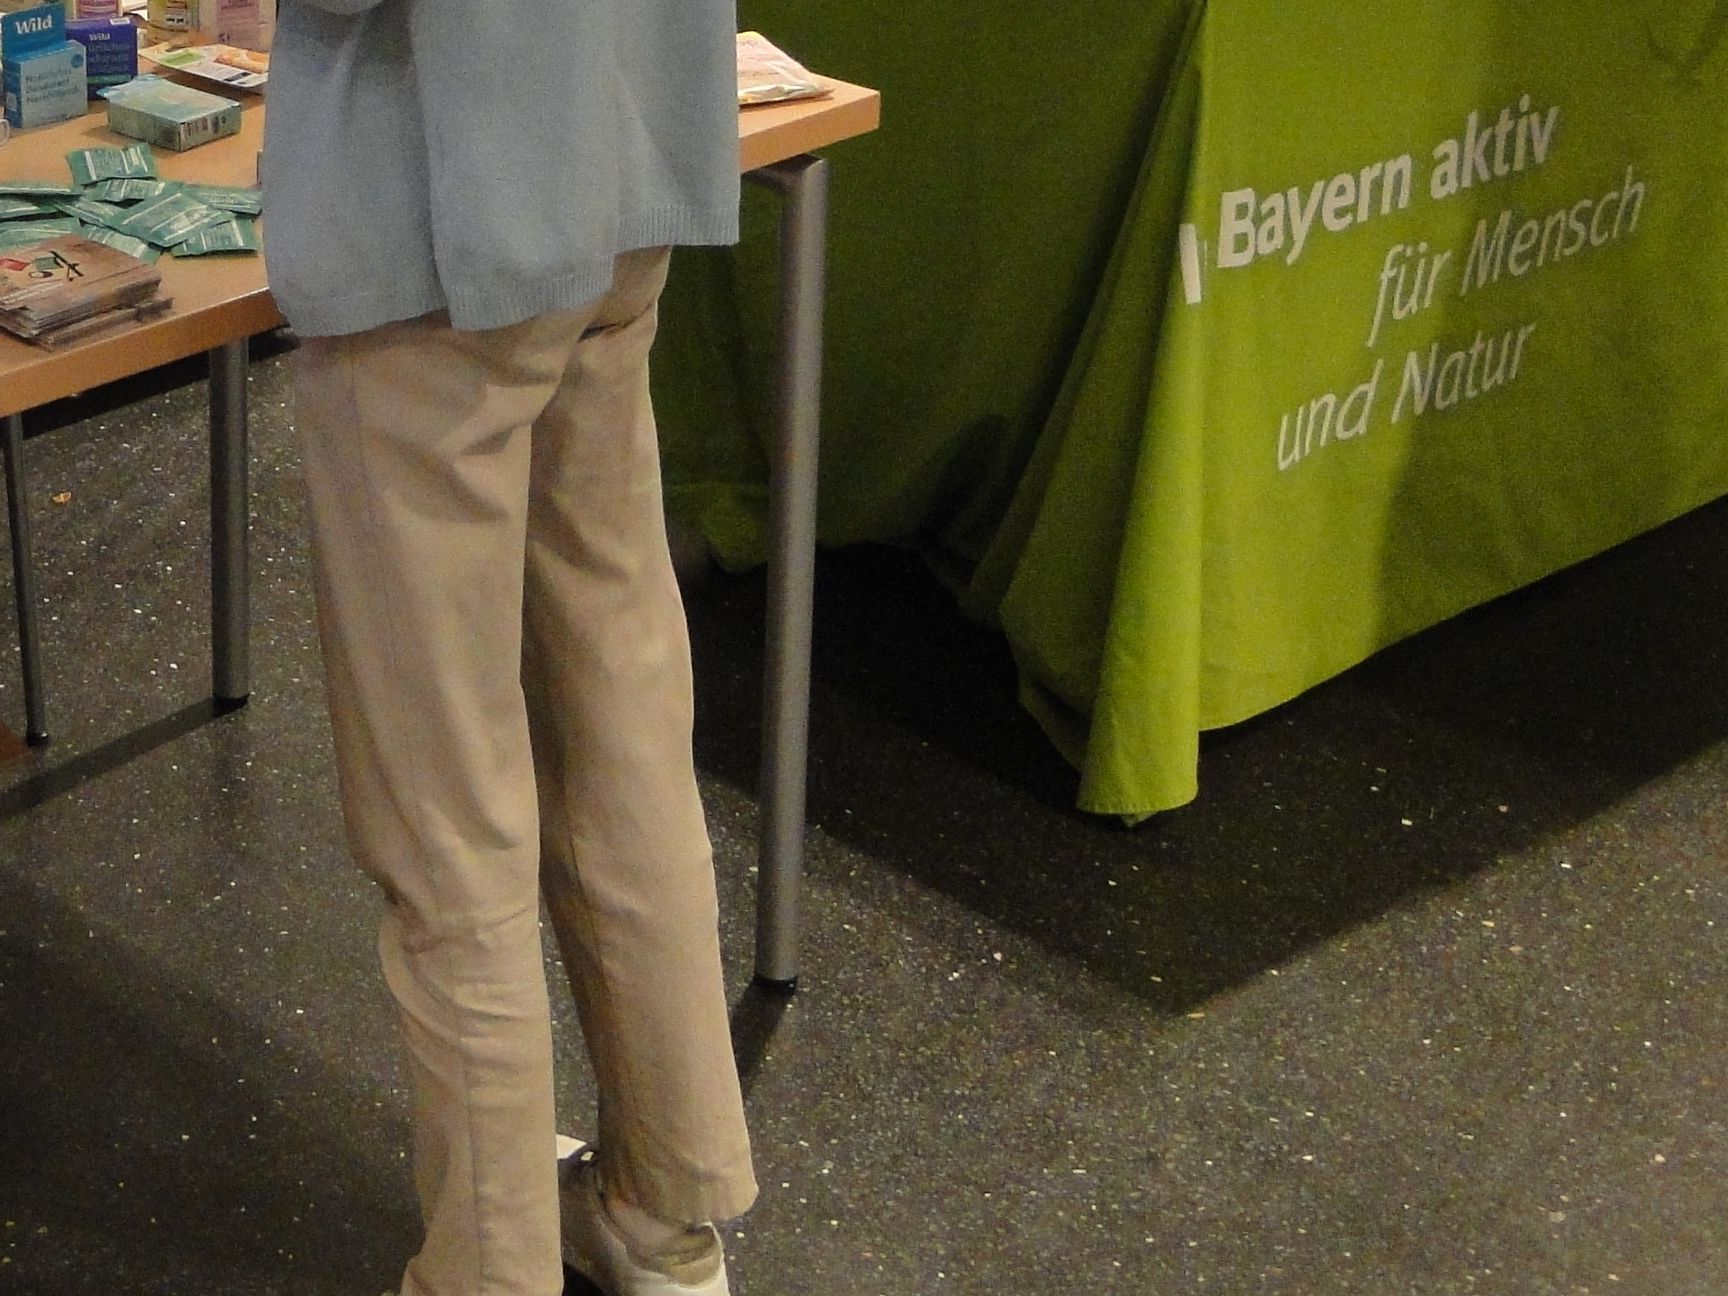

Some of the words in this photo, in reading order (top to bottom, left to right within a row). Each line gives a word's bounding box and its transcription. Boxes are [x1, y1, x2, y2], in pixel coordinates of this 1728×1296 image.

[15, 15, 52, 35] Wild
[88, 32, 111, 41] Wild
[1217, 151, 1412, 266] Bayern
[1430, 93, 1560, 200] aktiv
[1367, 241, 1451, 347] für
[1462, 164, 1646, 296] Mensch
[1277, 359, 1384, 471] und
[1391, 322, 1537, 424] Natur
